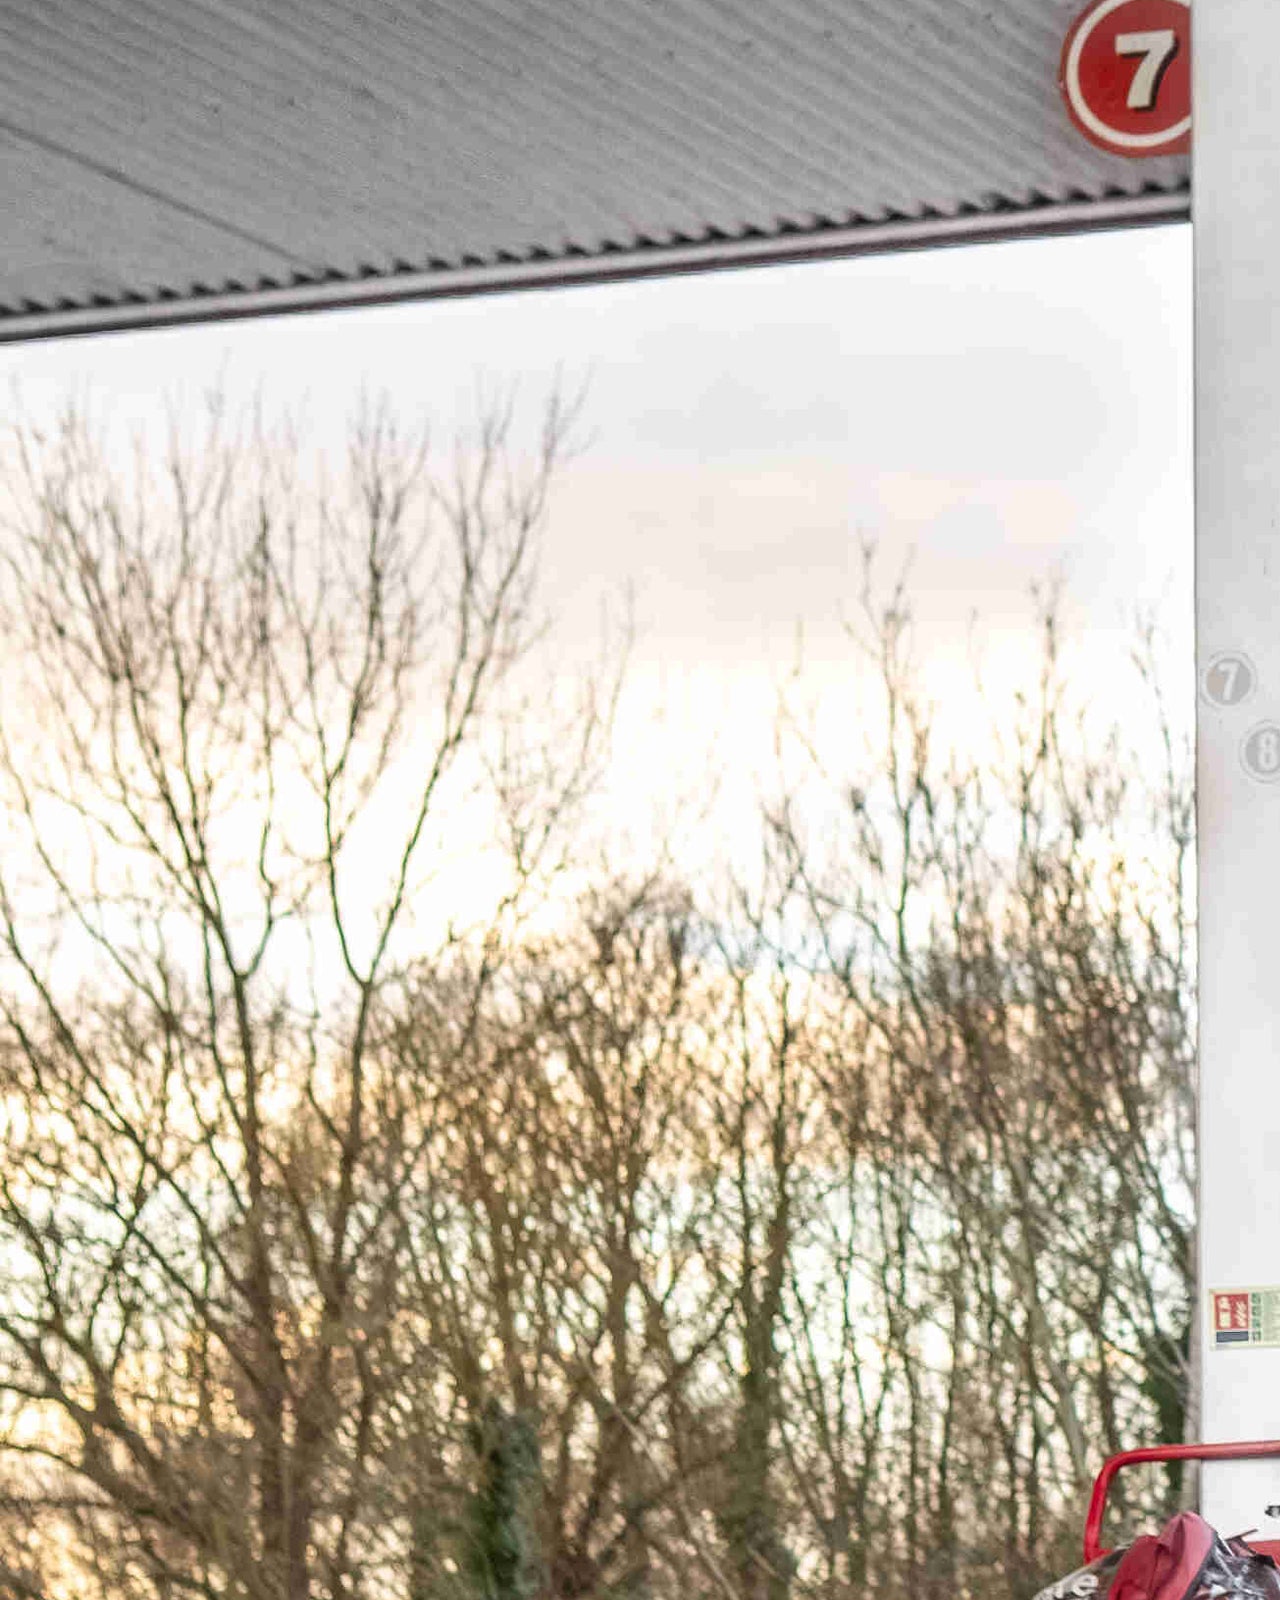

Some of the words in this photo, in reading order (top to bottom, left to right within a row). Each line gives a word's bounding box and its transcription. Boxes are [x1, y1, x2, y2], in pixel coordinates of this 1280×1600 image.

[1115, 29, 1177, 110] 7
[1218, 661, 1239, 701] 7
[1257, 731, 1278, 770] 8
